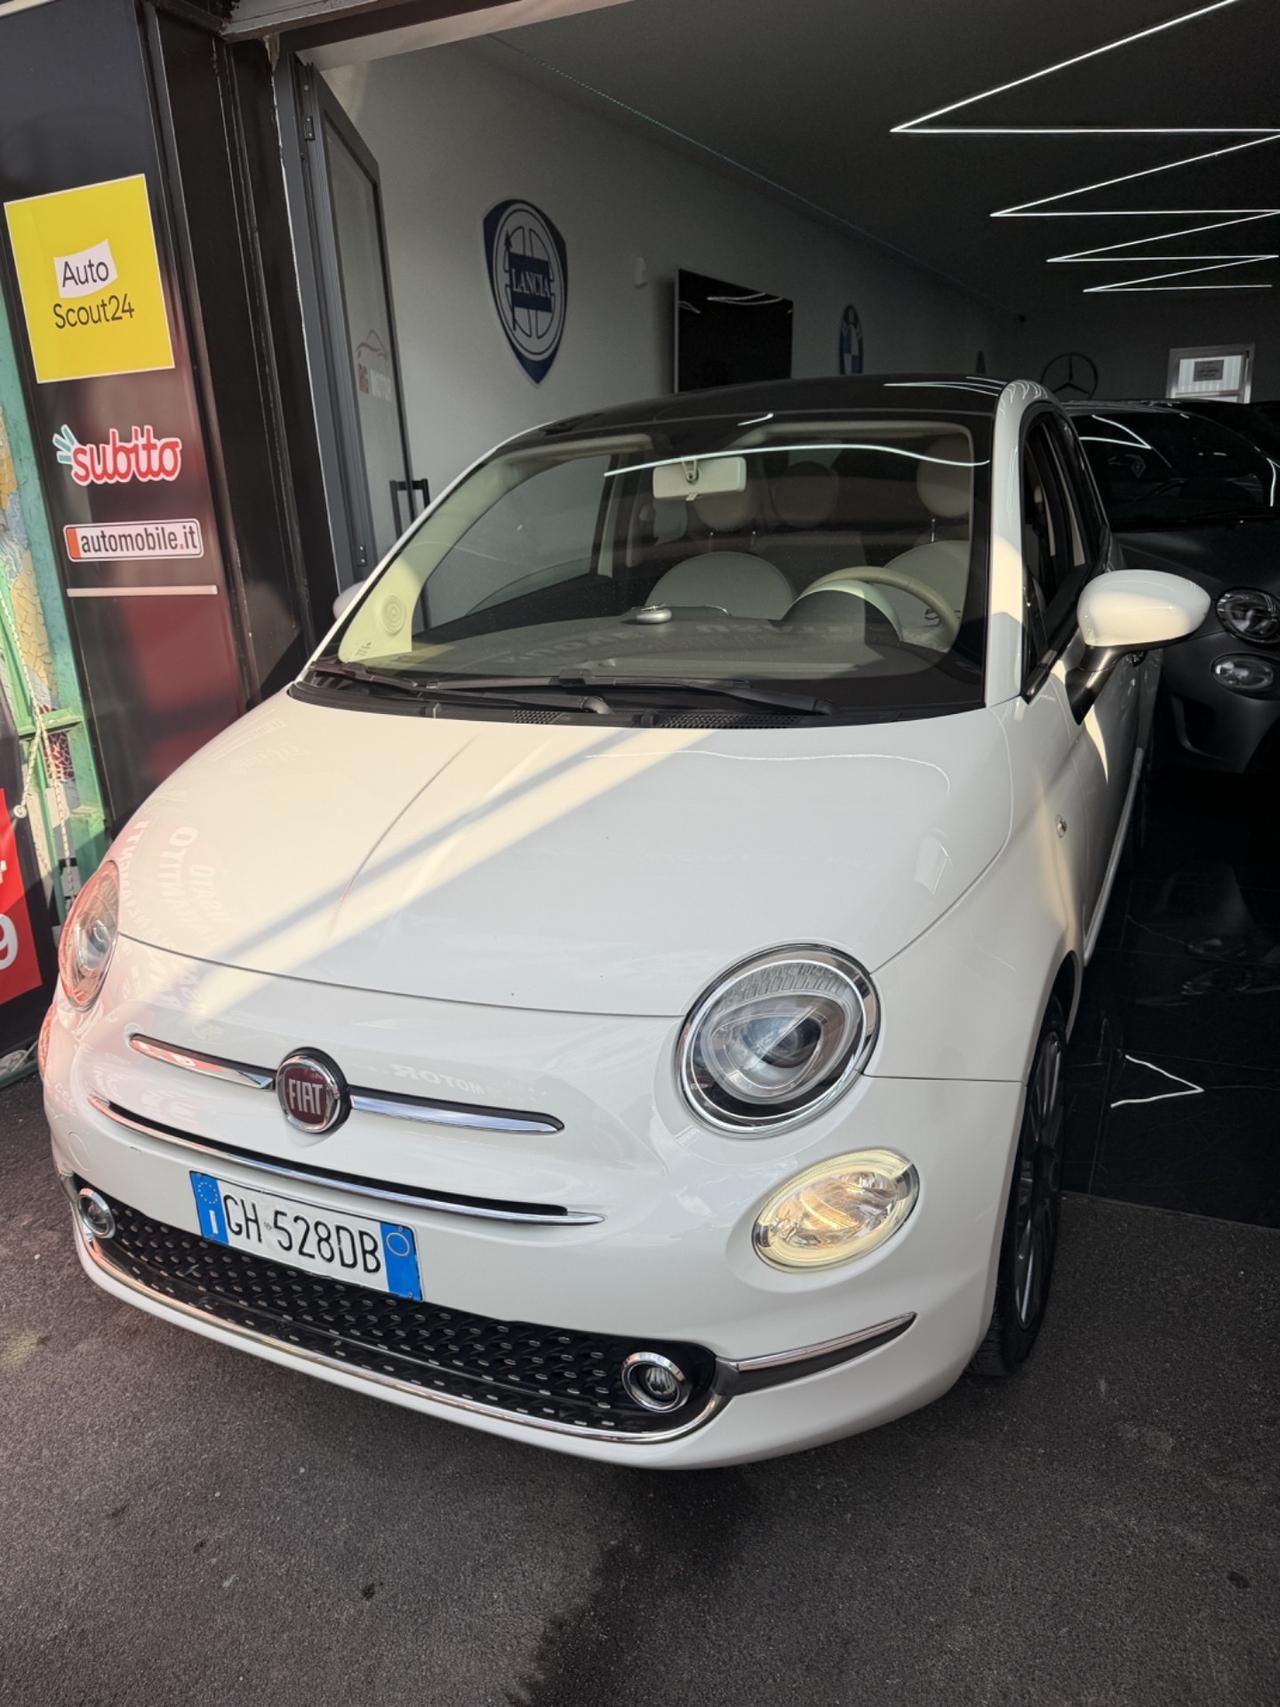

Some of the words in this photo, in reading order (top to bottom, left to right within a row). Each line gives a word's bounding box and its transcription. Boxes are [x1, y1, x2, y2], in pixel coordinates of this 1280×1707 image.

[62, 259, 109, 288] Auto
[511, 268, 550, 297] LANCIA
[52, 293, 135, 329] Scout24
[72, 426, 181, 484] subito
[80, 525, 198, 553] automobile.it
[288, 1078, 323, 1115] FIAT
[223, 1194, 263, 1243] GH
[273, 1209, 382, 1273] 528DB
